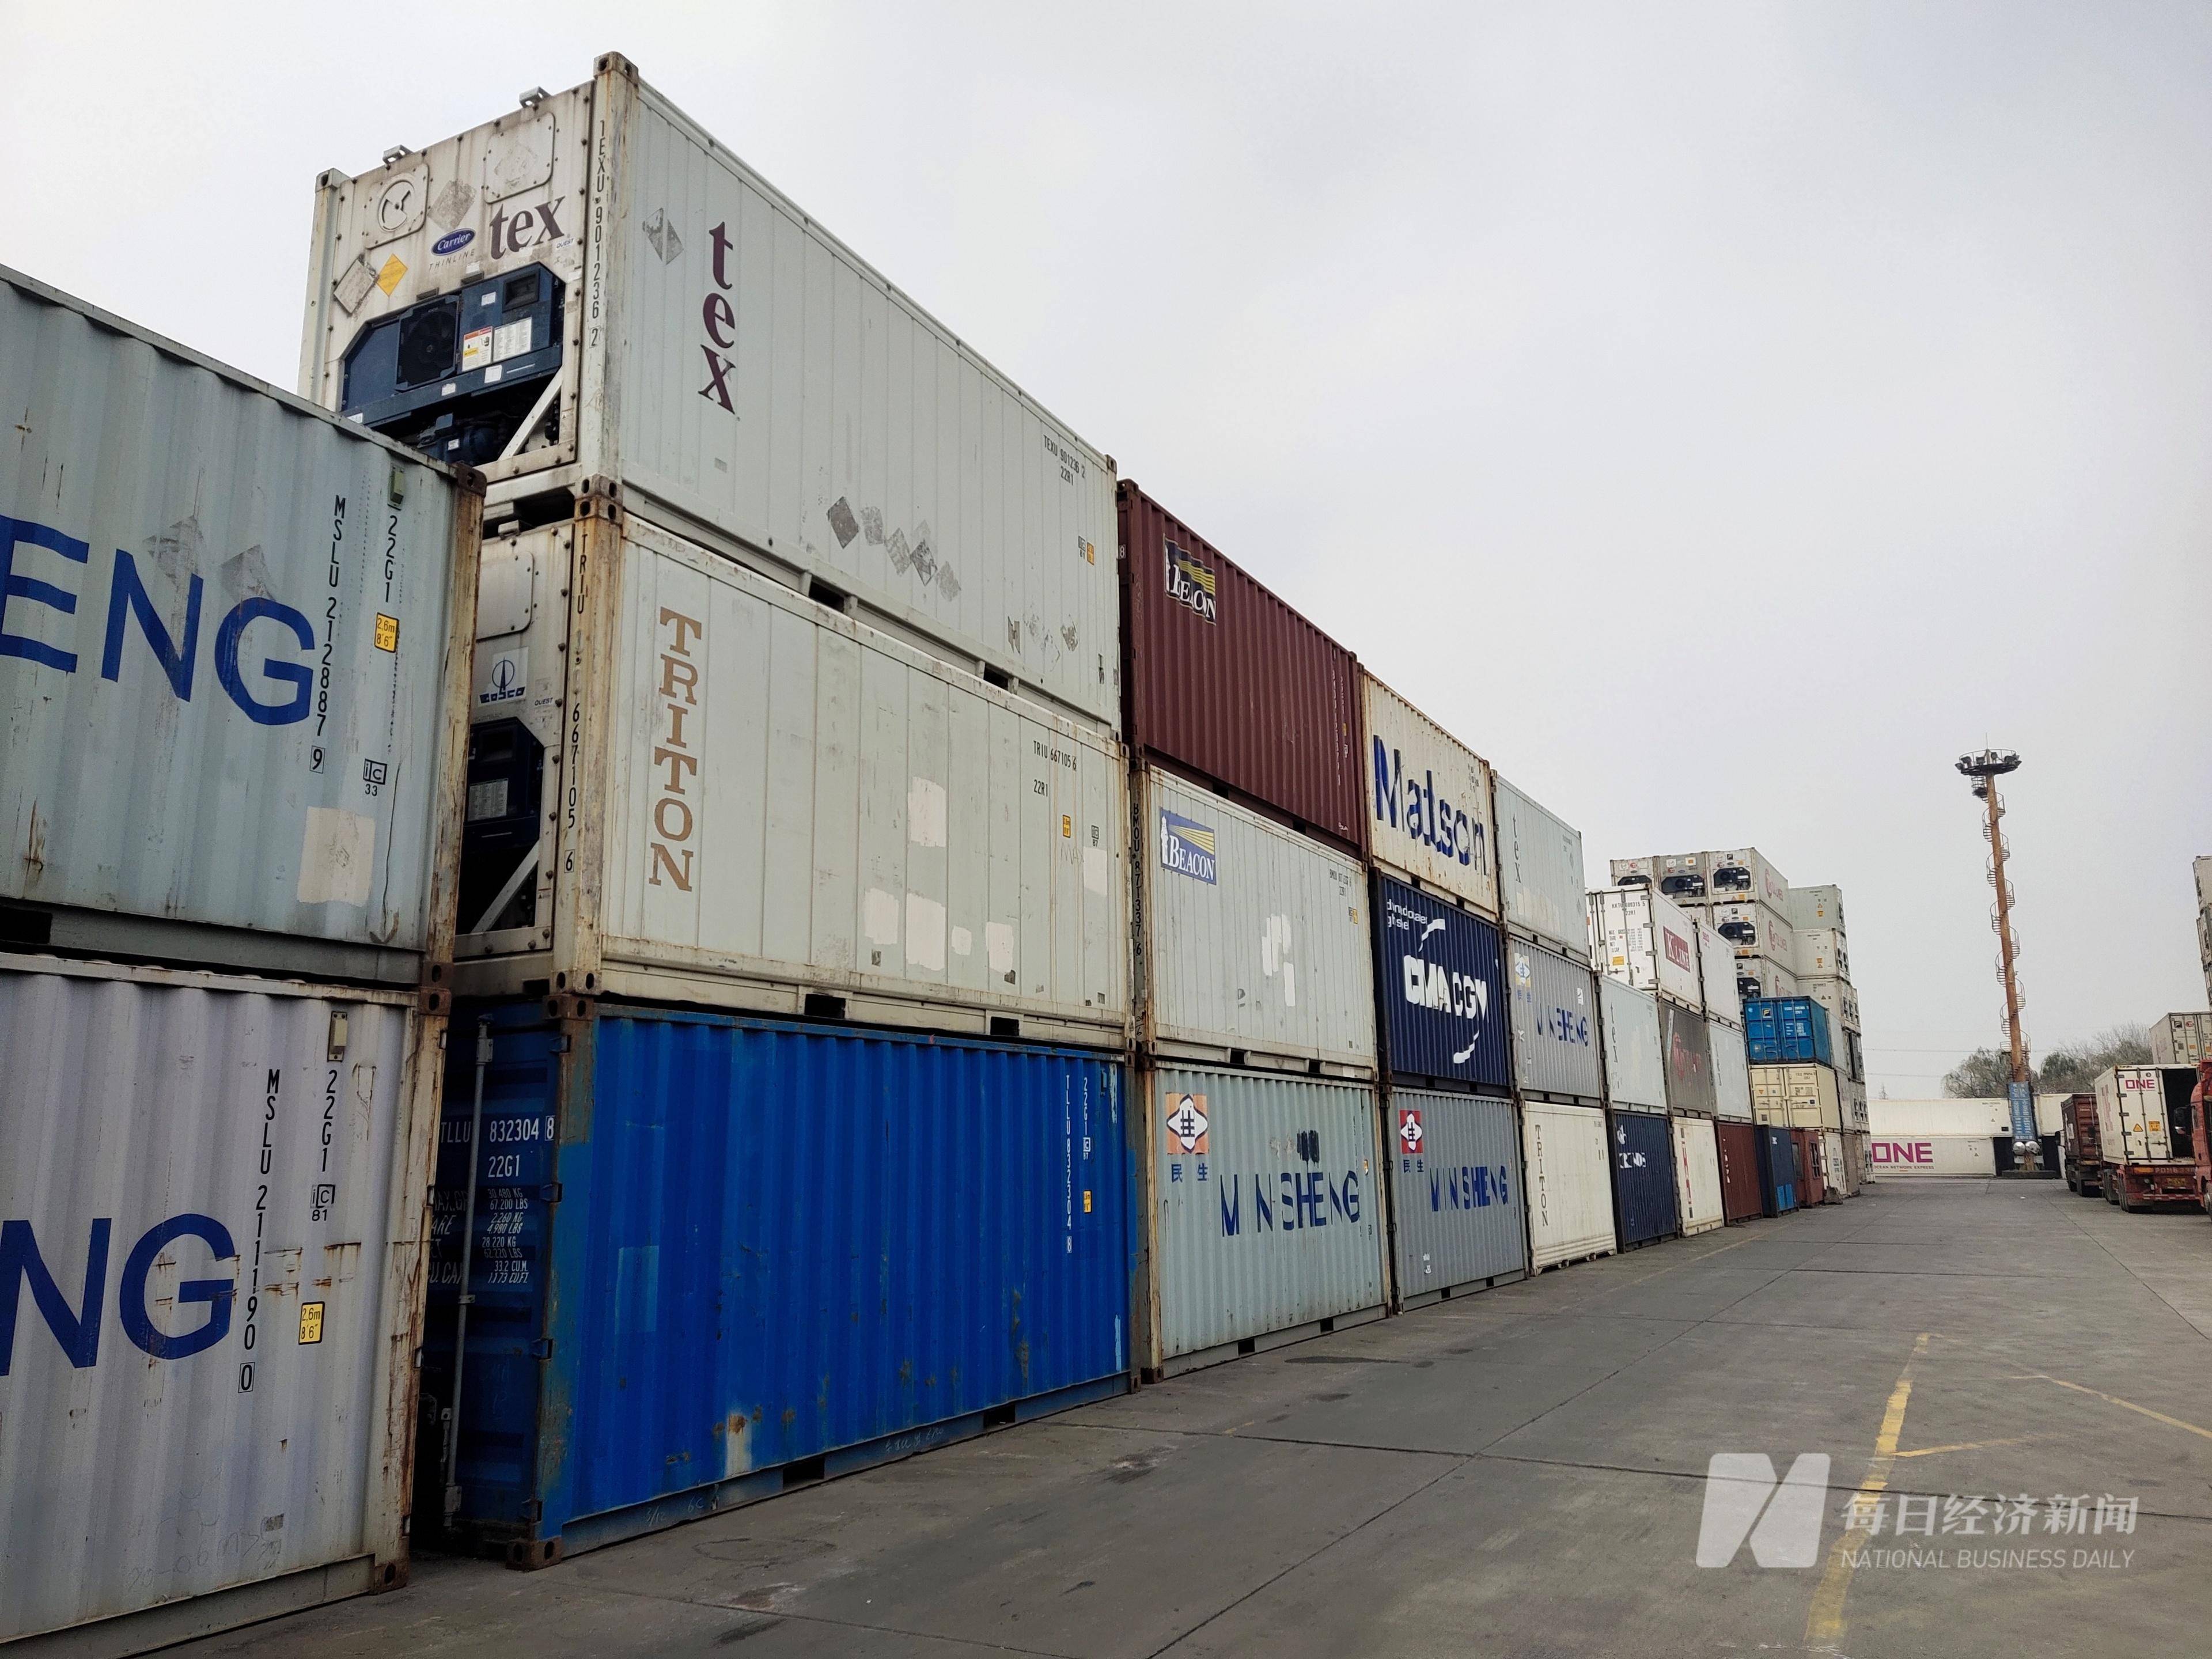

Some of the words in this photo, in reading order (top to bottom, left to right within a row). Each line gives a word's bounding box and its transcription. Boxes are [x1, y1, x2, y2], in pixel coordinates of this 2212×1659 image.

[488, 195, 565, 260] tex
[437, 233, 471, 251] Carrier
[556, 238, 574, 249] QUEST
[428, 248, 476, 271] THINLINE
[592, 206, 603, 319] 901236
[698, 221, 736, 415] tex
[590, 327, 599, 347] 2
[1044, 434, 1058, 457] TEXU
[1060, 449, 1080, 474] 901236
[1082, 465, 1085, 479] 2
[1060, 465, 1074, 486] 22R1
[328, 495, 346, 588] MSLU
[383, 515, 399, 603] 22G1
[577, 533, 588, 614] TRIU
[0, 514, 316, 726] ENG
[316, 597, 337, 737] 212887
[479, 686, 525, 704] COSCO
[534, 697, 553, 706] QUEST
[312, 748, 323, 771] 9
[648, 606, 702, 892] TRITON
[1033, 740, 1048, 759] TRIU
[1050, 749, 1071, 769] 667105
[1072, 756, 1077, 771] 6
[568, 702, 580, 829] 667105
[364, 783, 378, 797] 33
[1033, 778, 1048, 797] 22R1
[1373, 734, 1487, 876] Matson
[566, 851, 573, 871] 6
[1169, 835, 1215, 880] BEACON
[1135, 942, 1142, 956] 6
[2125, 1079, 2156, 1089] ONE
[260, 1069, 280, 1175] MSLU
[321, 1069, 338, 1172] 22G1
[441, 1119, 472, 1143] TLLU
[489, 1118, 539, 1143] 832304
[546, 1117, 554, 1139] 8
[1872, 1142, 1933, 1163] ONE
[488, 1155, 520, 1178] 22G1
[1171, 1163, 1209, 1183] 民生
[1535, 1124, 1548, 1227] TRITON
[490, 1199, 513, 1210] 67.200
[516, 1198, 528, 1209] LBS
[512, 1188, 523, 1198] KG
[312, 1209, 328, 1221] 81
[491, 1212, 512, 1224] 2.260
[512, 1211, 524, 1222] KG
[487, 1223, 506, 1234] 4.980
[508, 1222, 523, 1234] LBS
[482, 1236, 505, 1248] 28.220
[507, 1236, 516, 1248] KG
[508, 1248, 522, 1258] LBS
[1067, 1237, 1072, 1252] 8
[244, 1185, 268, 1351] 211190
[494, 1260, 509, 1272] 33.2
[0, 1213, 237, 1376] NG
[241, 1364, 252, 1391] 0
